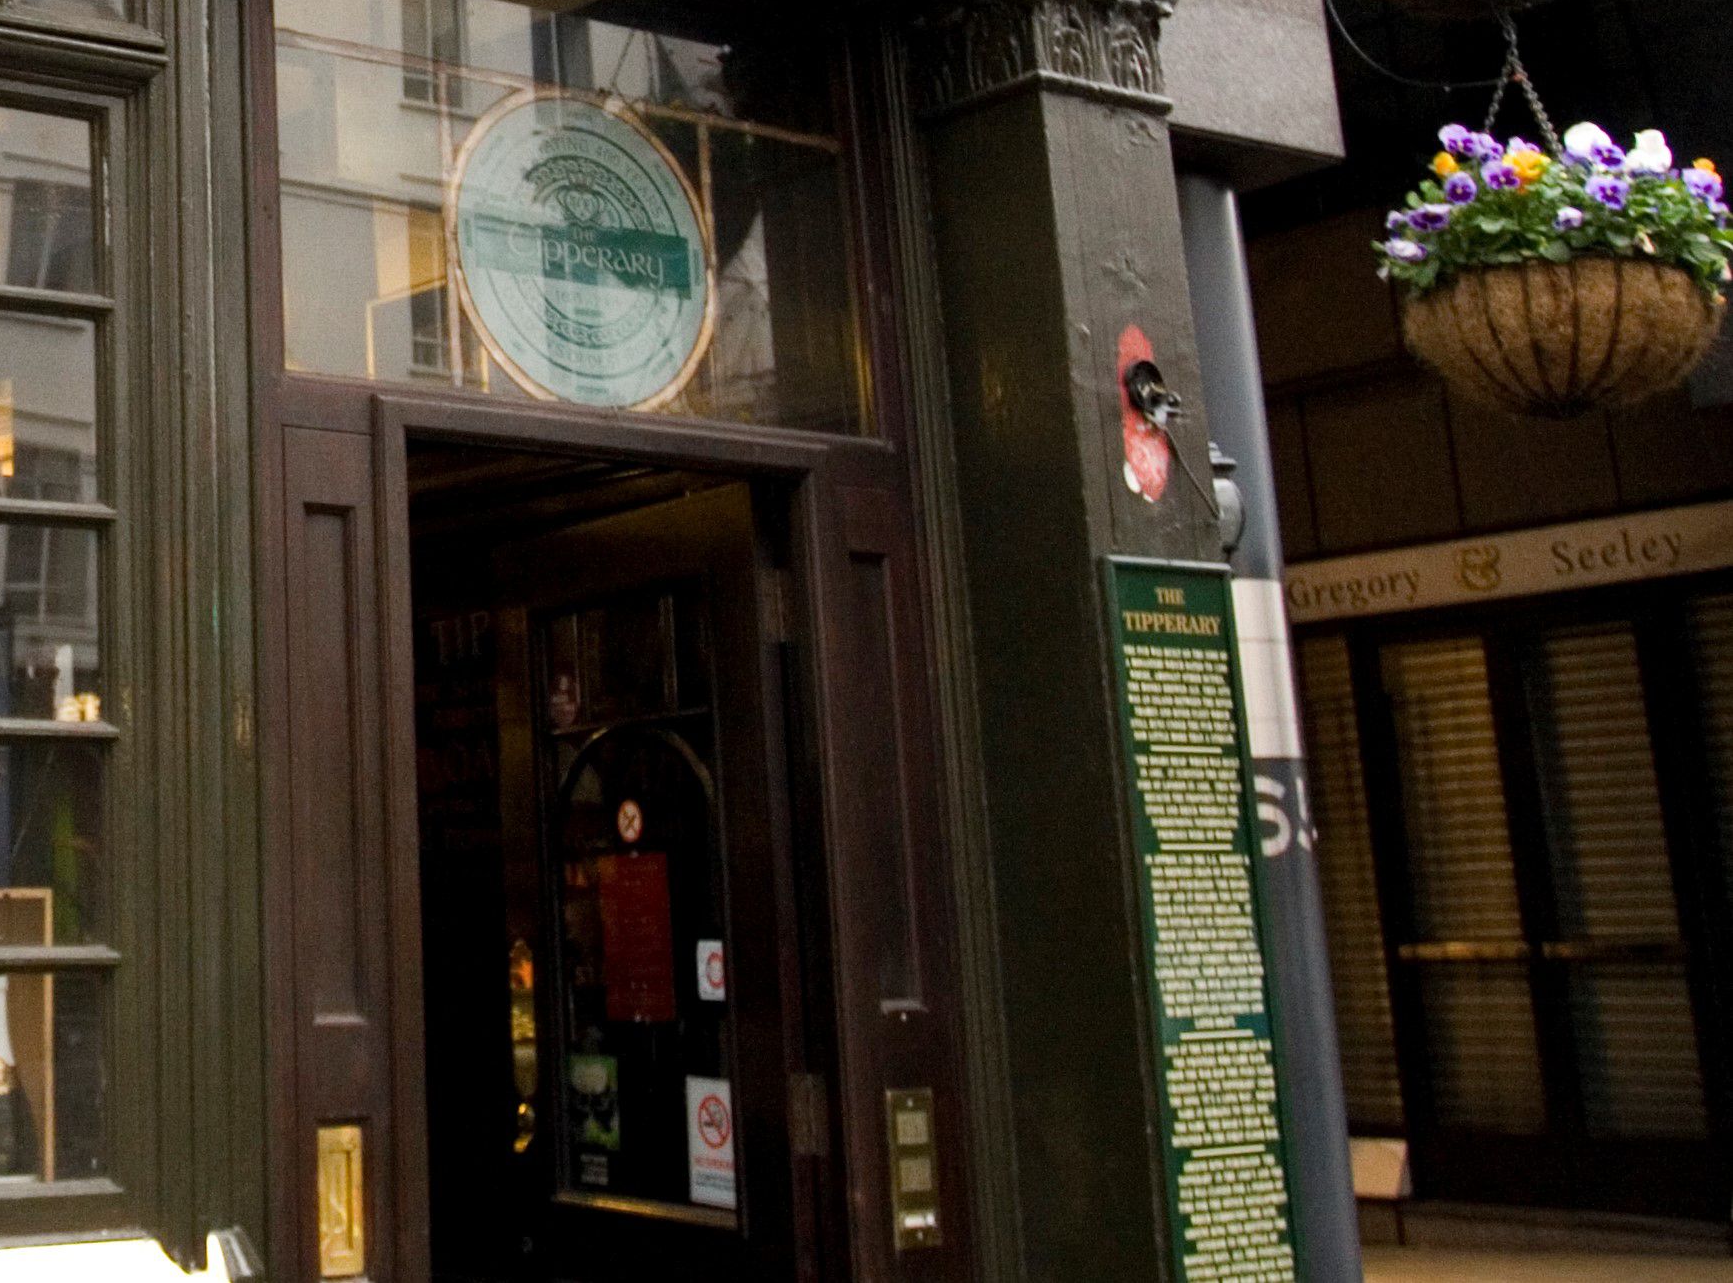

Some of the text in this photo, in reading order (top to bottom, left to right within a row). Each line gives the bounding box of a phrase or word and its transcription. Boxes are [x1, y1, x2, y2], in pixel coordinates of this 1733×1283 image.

[1286, 528, 1686, 613] Gregory & Seeley
[1154, 586, 1186, 606] THE
[1122, 611, 1223, 637] TIPPERARY
